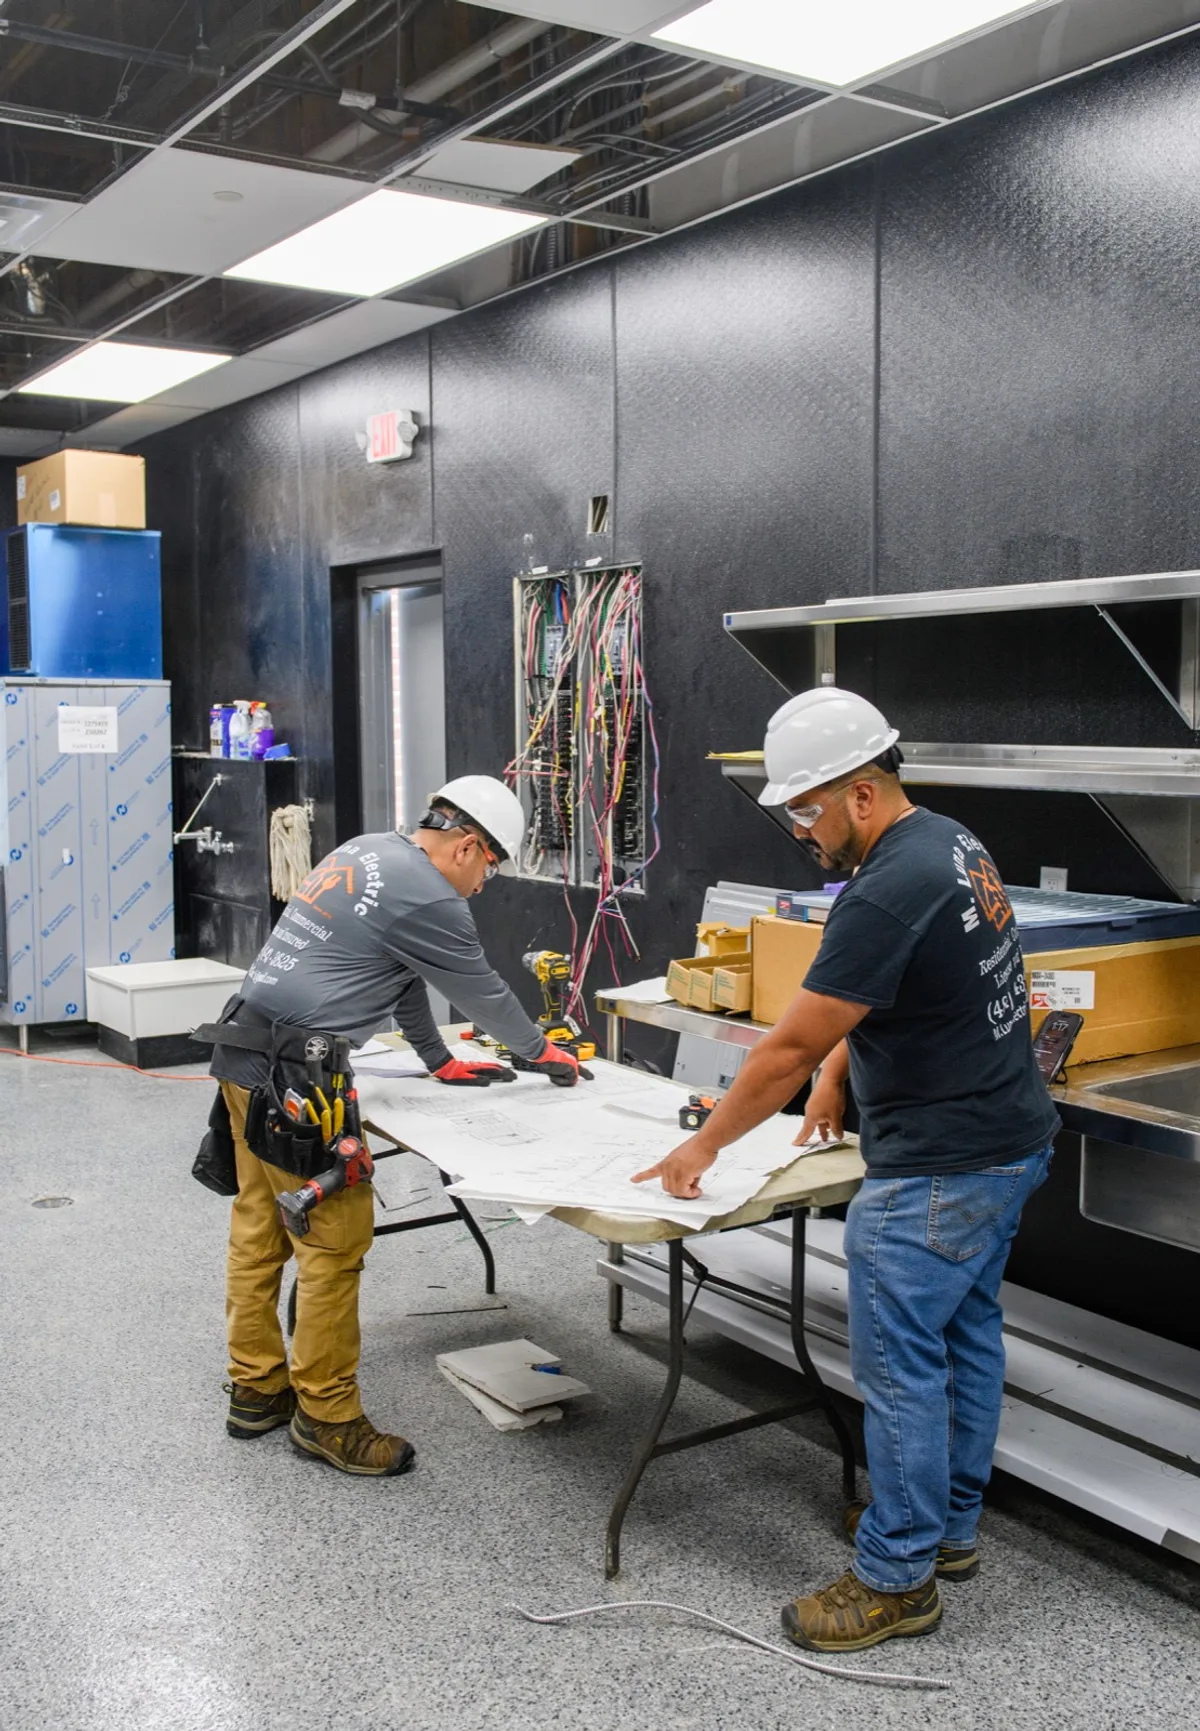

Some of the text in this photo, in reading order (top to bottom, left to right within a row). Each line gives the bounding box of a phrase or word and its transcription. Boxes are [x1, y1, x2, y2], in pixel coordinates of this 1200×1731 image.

[372, 412, 397, 459] EXIT
[354, 852, 384, 916] Electric
[953, 846, 972, 888] Luna
[961, 897, 980, 933] M.
